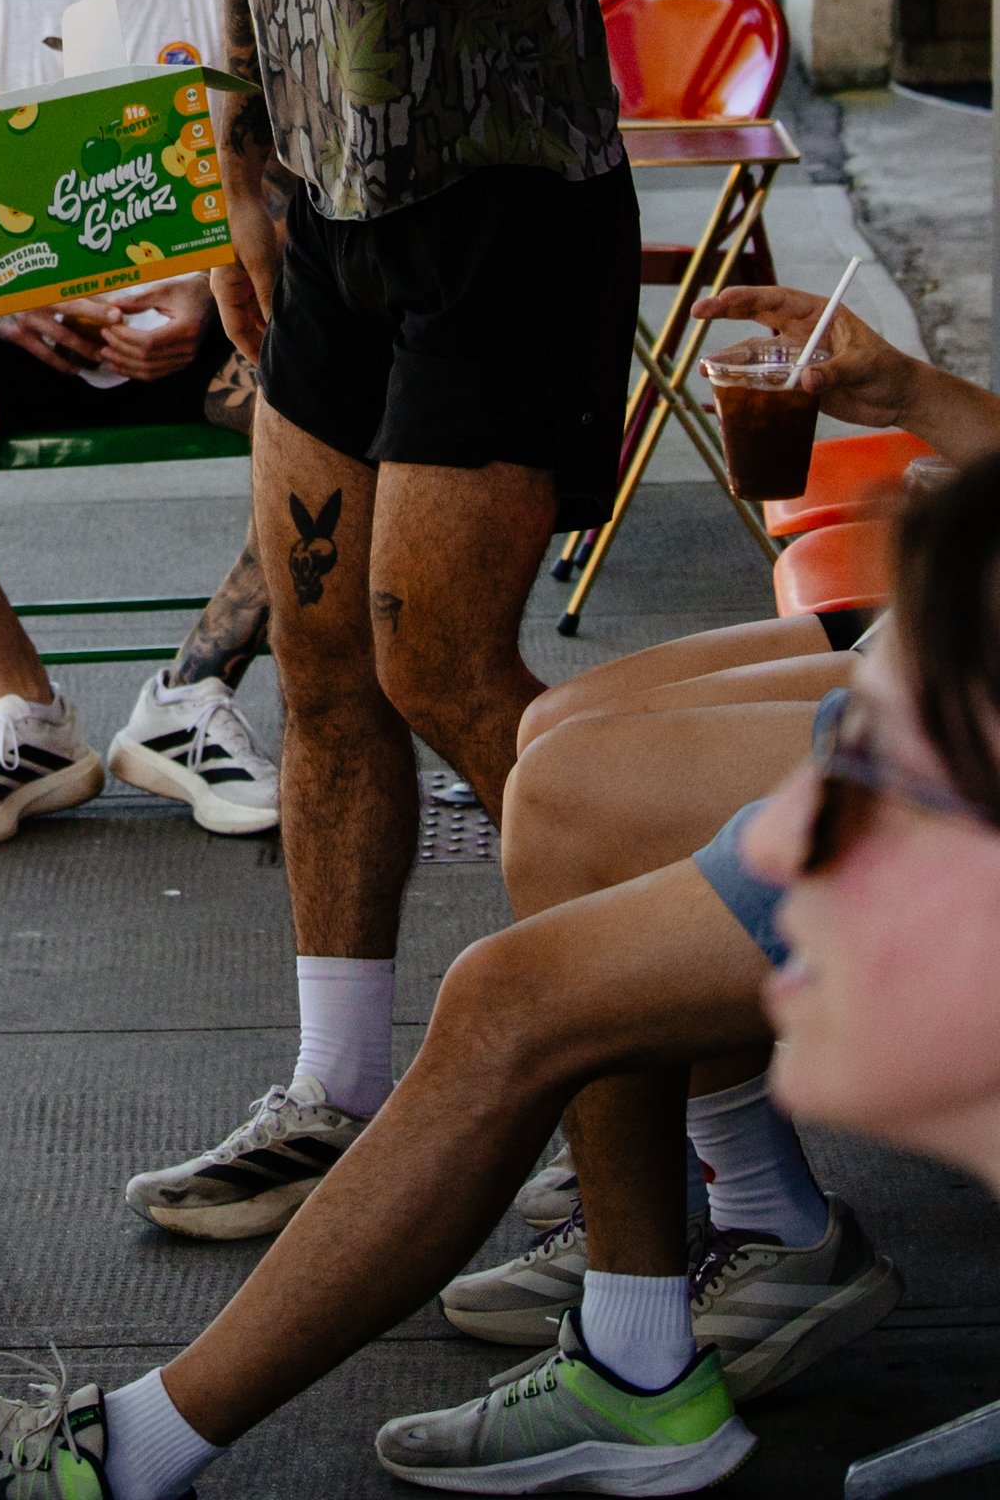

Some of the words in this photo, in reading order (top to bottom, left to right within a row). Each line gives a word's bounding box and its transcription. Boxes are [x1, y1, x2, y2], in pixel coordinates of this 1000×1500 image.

[115, 114, 160, 137] PROTEIN
[47, 152, 158, 222] Gummy
[78, 184, 177, 252] Gainz
[18, 255, 56, 273] CANDY!
[60, 280, 99, 297] GREEN
[104, 270, 141, 289] APPLE
